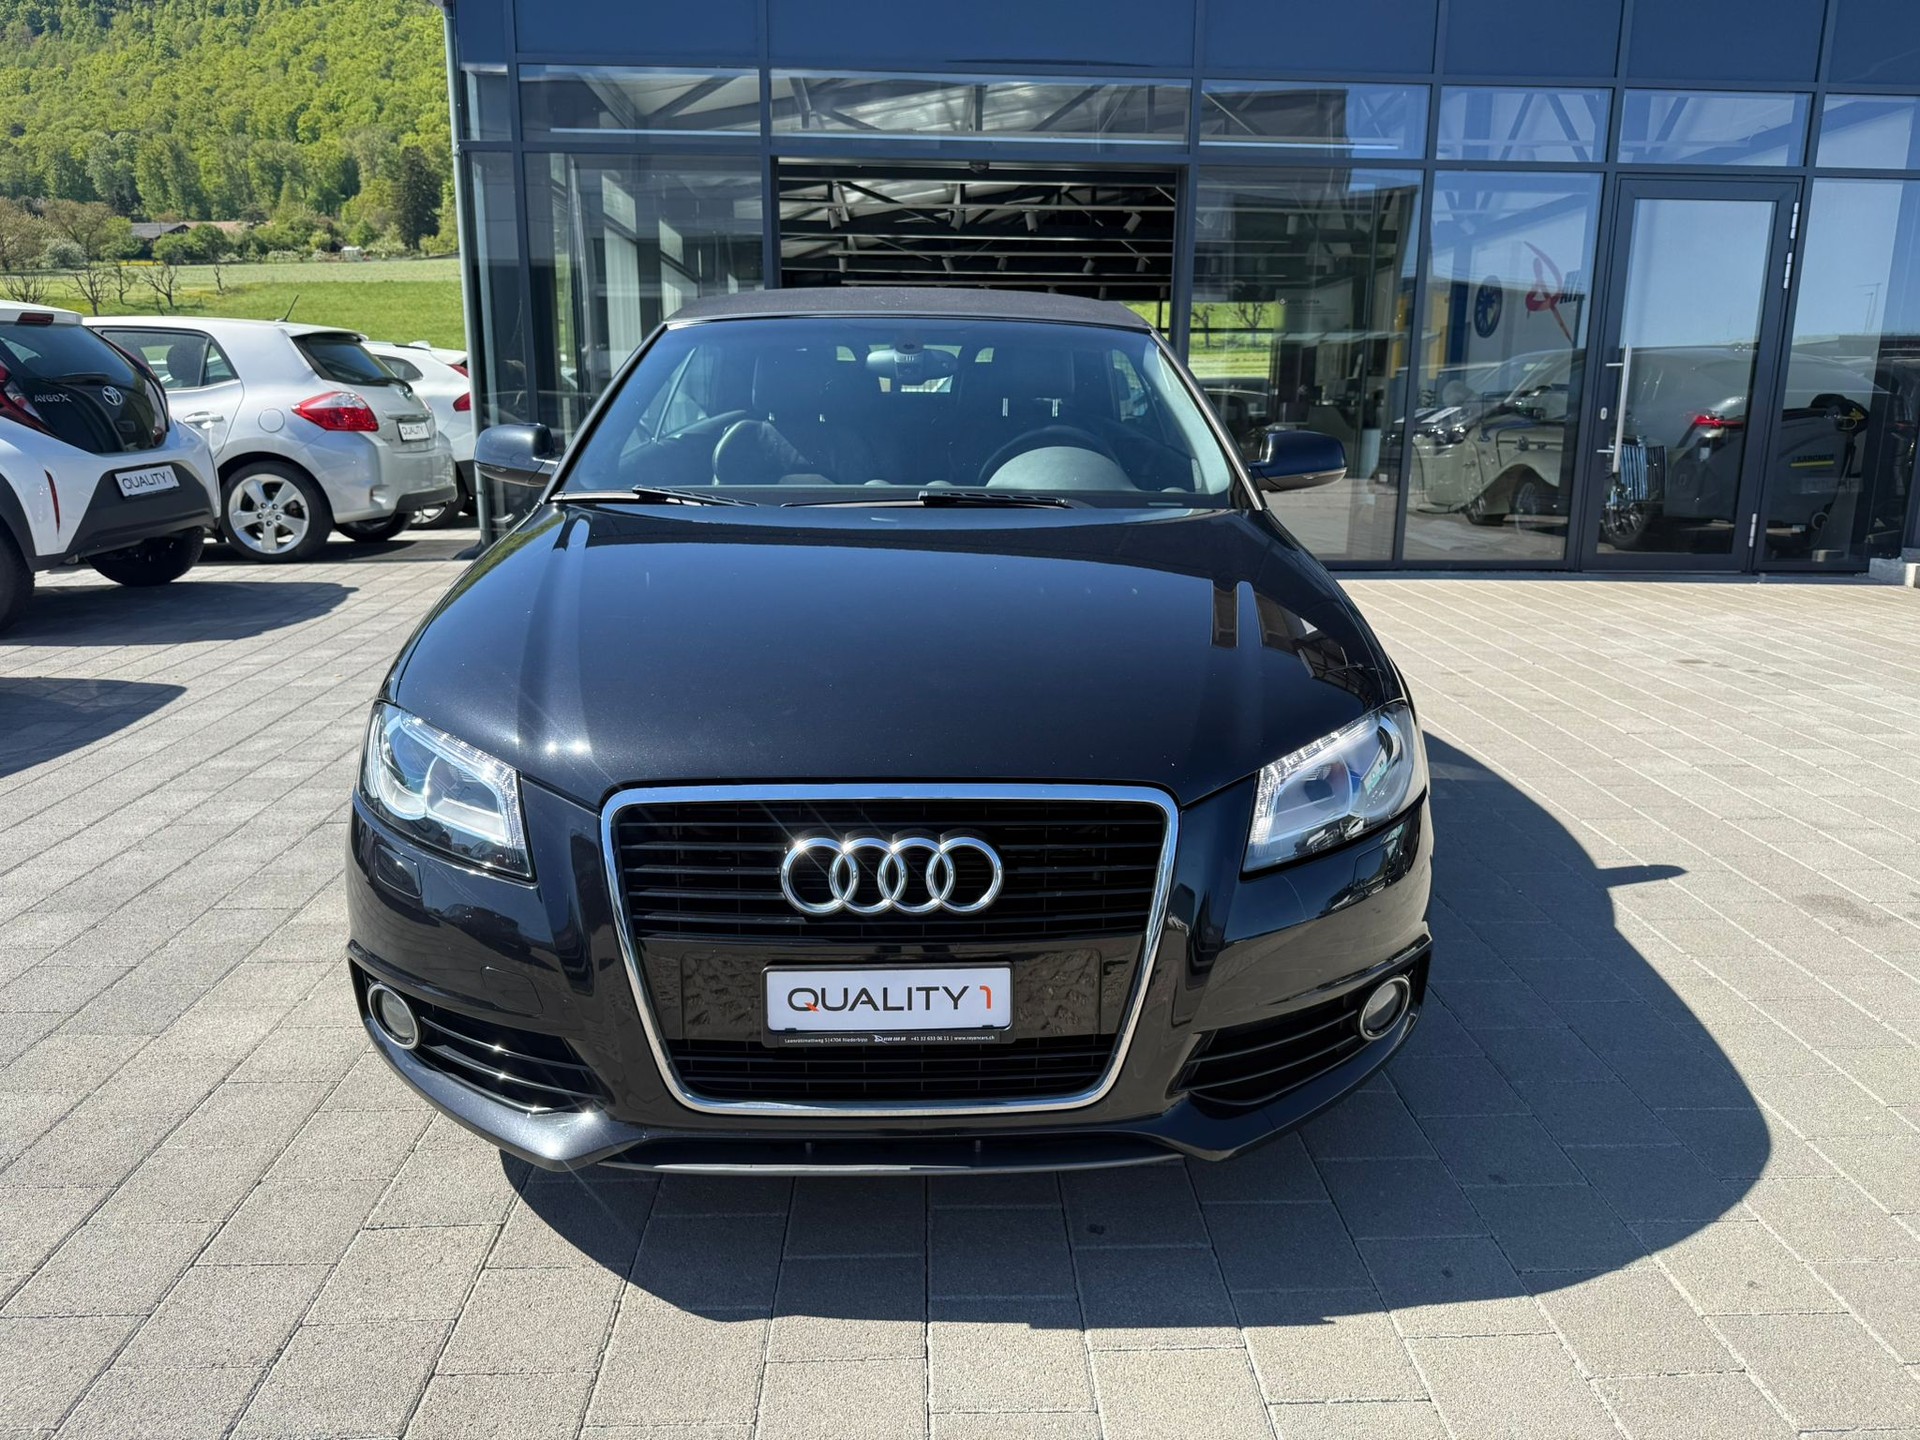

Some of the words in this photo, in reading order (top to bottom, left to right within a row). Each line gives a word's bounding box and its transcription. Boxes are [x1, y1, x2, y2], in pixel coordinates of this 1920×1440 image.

[122, 471, 167, 489] QUALITY
[787, 985, 970, 1012] QUALITY
[979, 985, 992, 1010] 1
